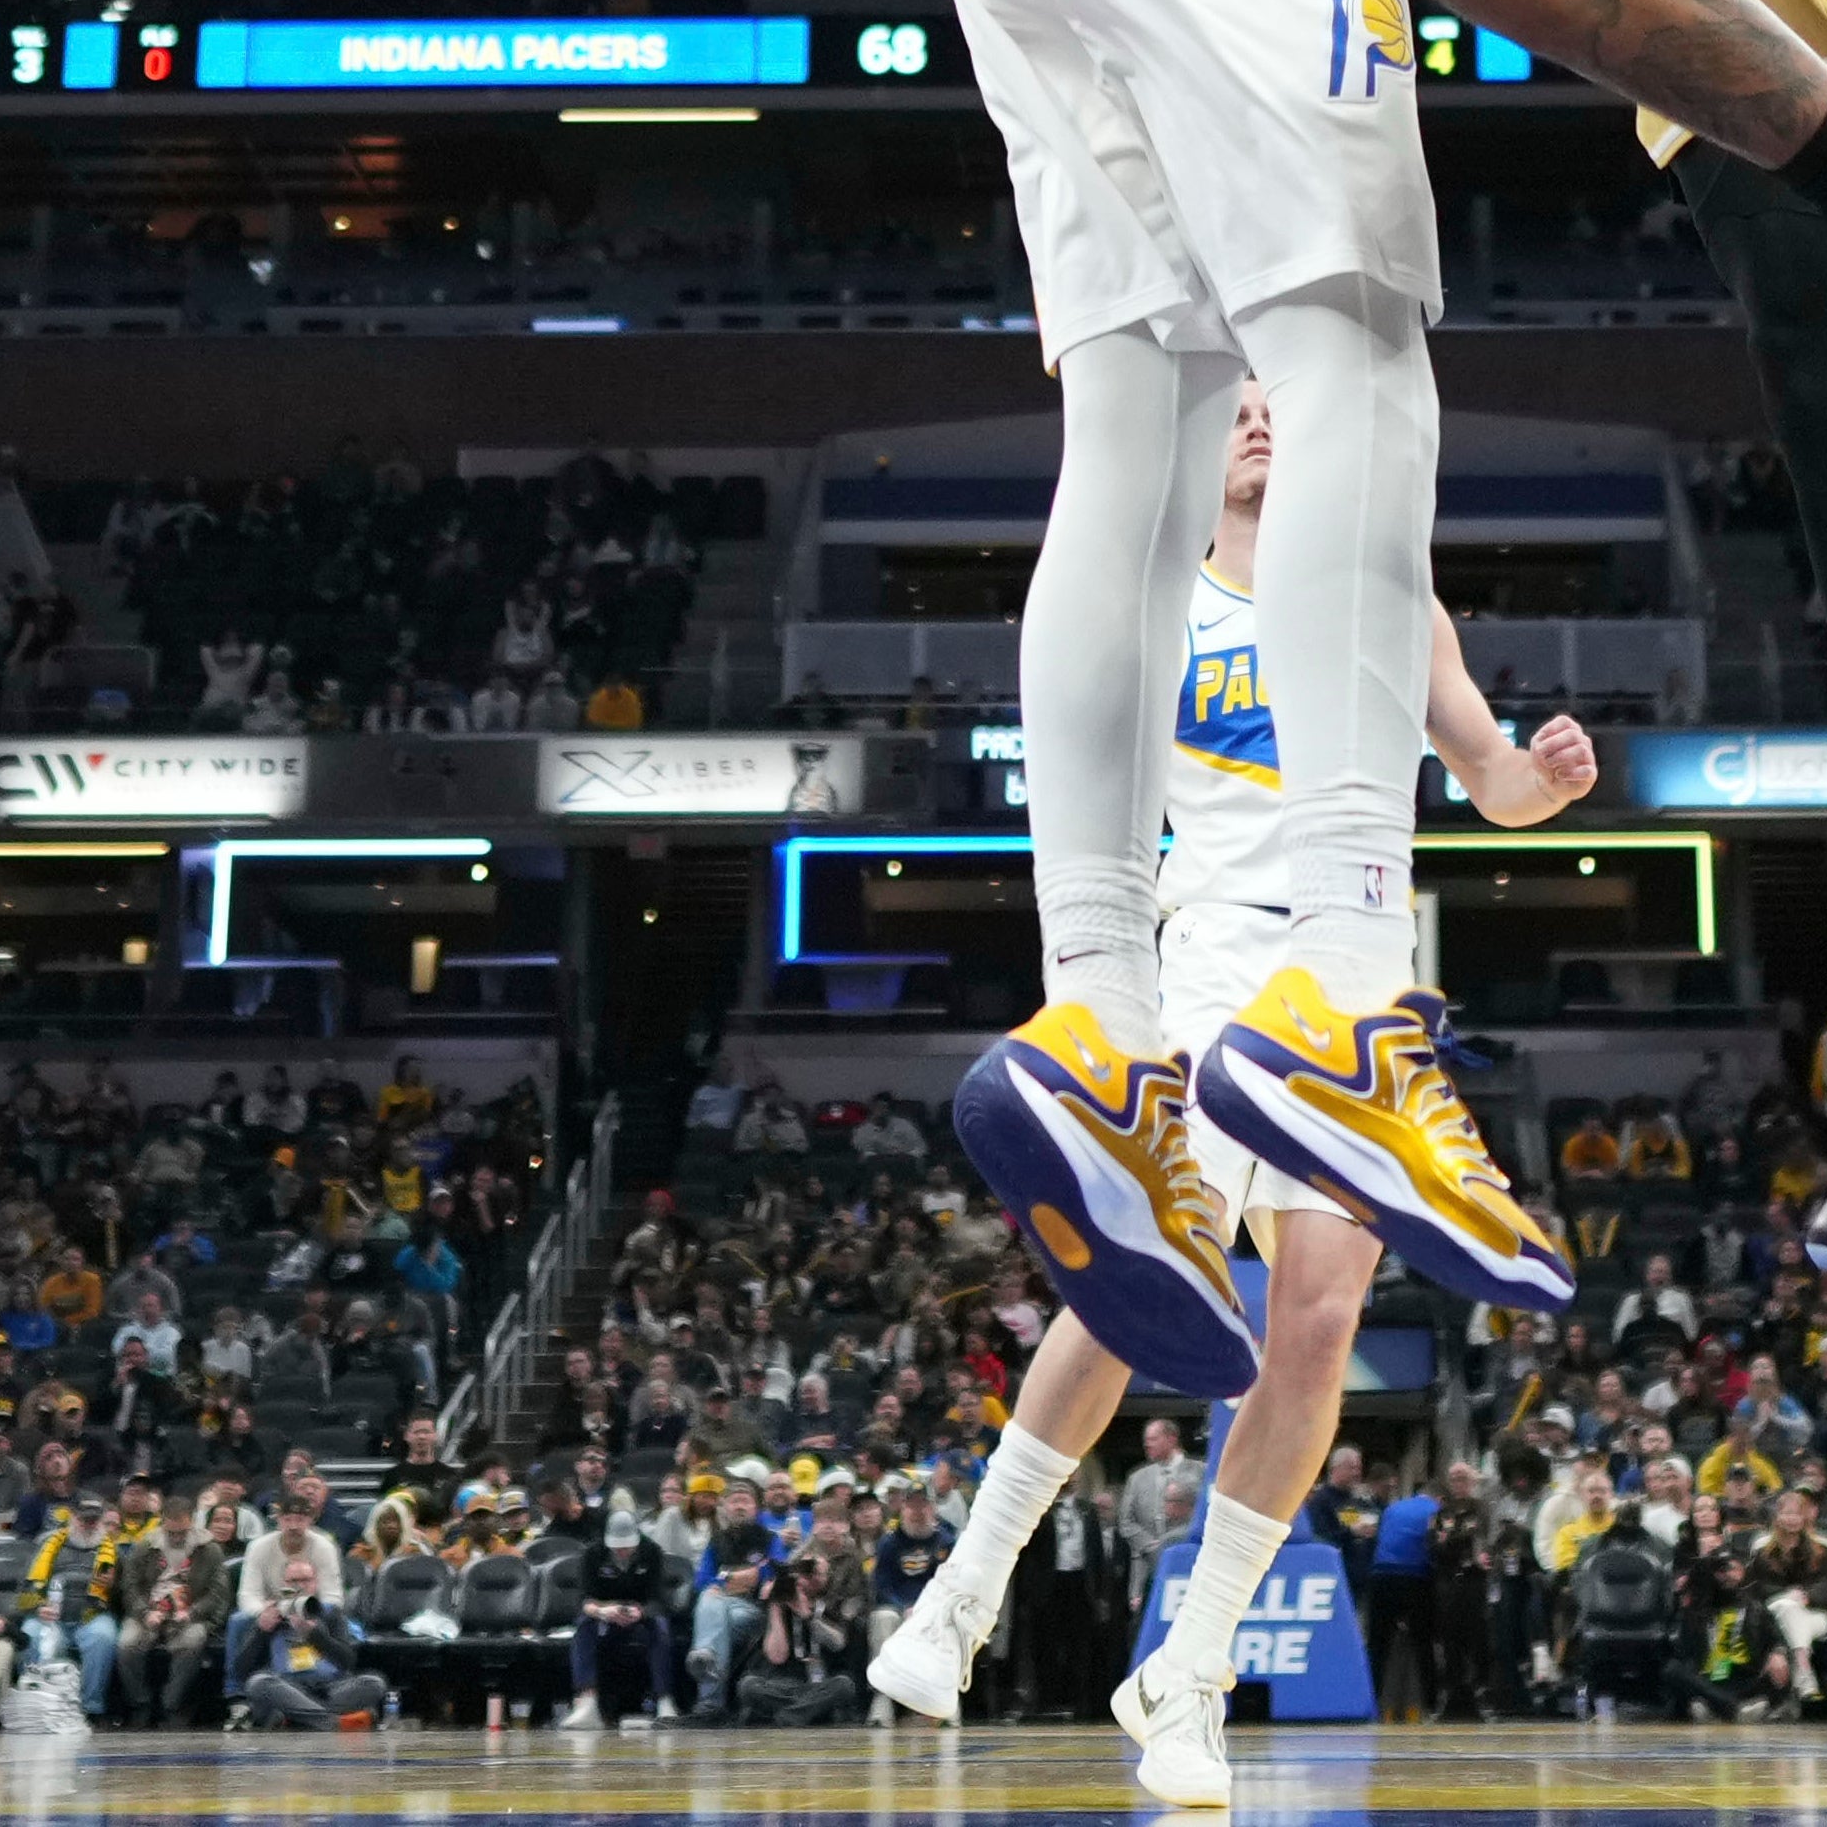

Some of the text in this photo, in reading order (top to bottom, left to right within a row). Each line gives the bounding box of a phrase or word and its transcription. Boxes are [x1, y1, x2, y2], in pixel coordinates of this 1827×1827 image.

[14, 47, 42, 82] 3
[144, 45, 171, 80] 0
[339, 34, 668, 72] INDIANA PACERS
[860, 27, 925, 73] 68
[1427, 38, 1454, 74] 4
[114, 758, 193, 777] CITY
[211, 757, 300, 776] WIDE
[652, 757, 757, 778] XIBER
[1235, 1630, 1312, 1674] RE
